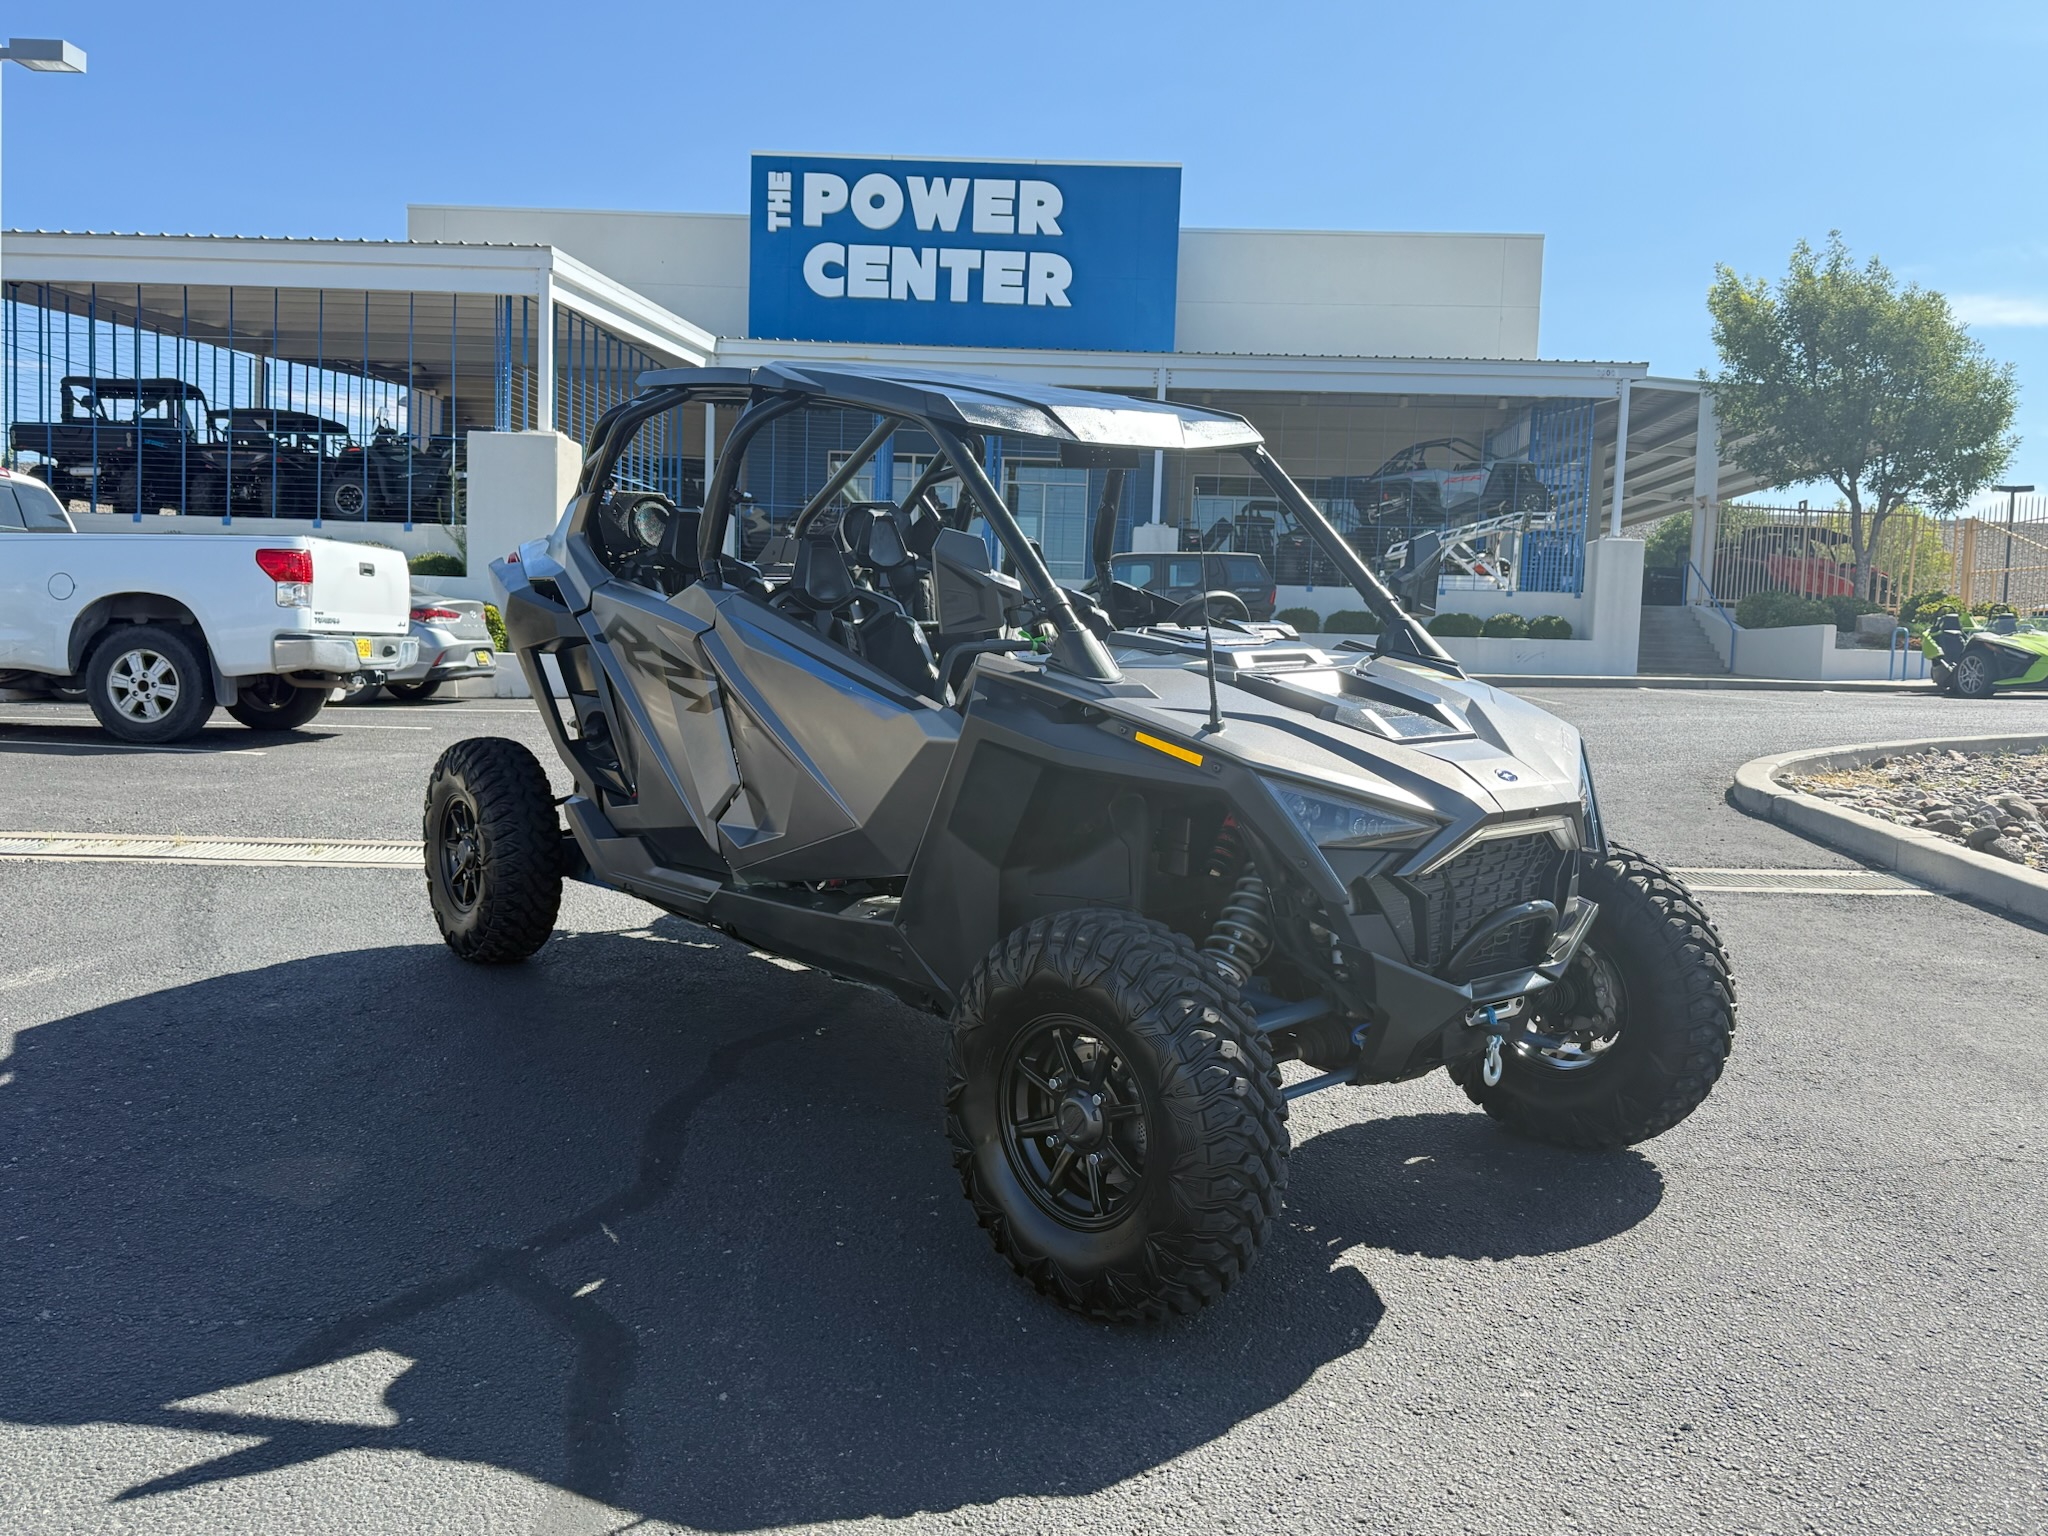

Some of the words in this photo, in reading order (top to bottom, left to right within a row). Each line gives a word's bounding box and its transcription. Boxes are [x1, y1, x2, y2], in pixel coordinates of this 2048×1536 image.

[768, 171, 792, 232] THE
[803, 172, 1064, 236] POWER
[803, 242, 1073, 307] CENTER
